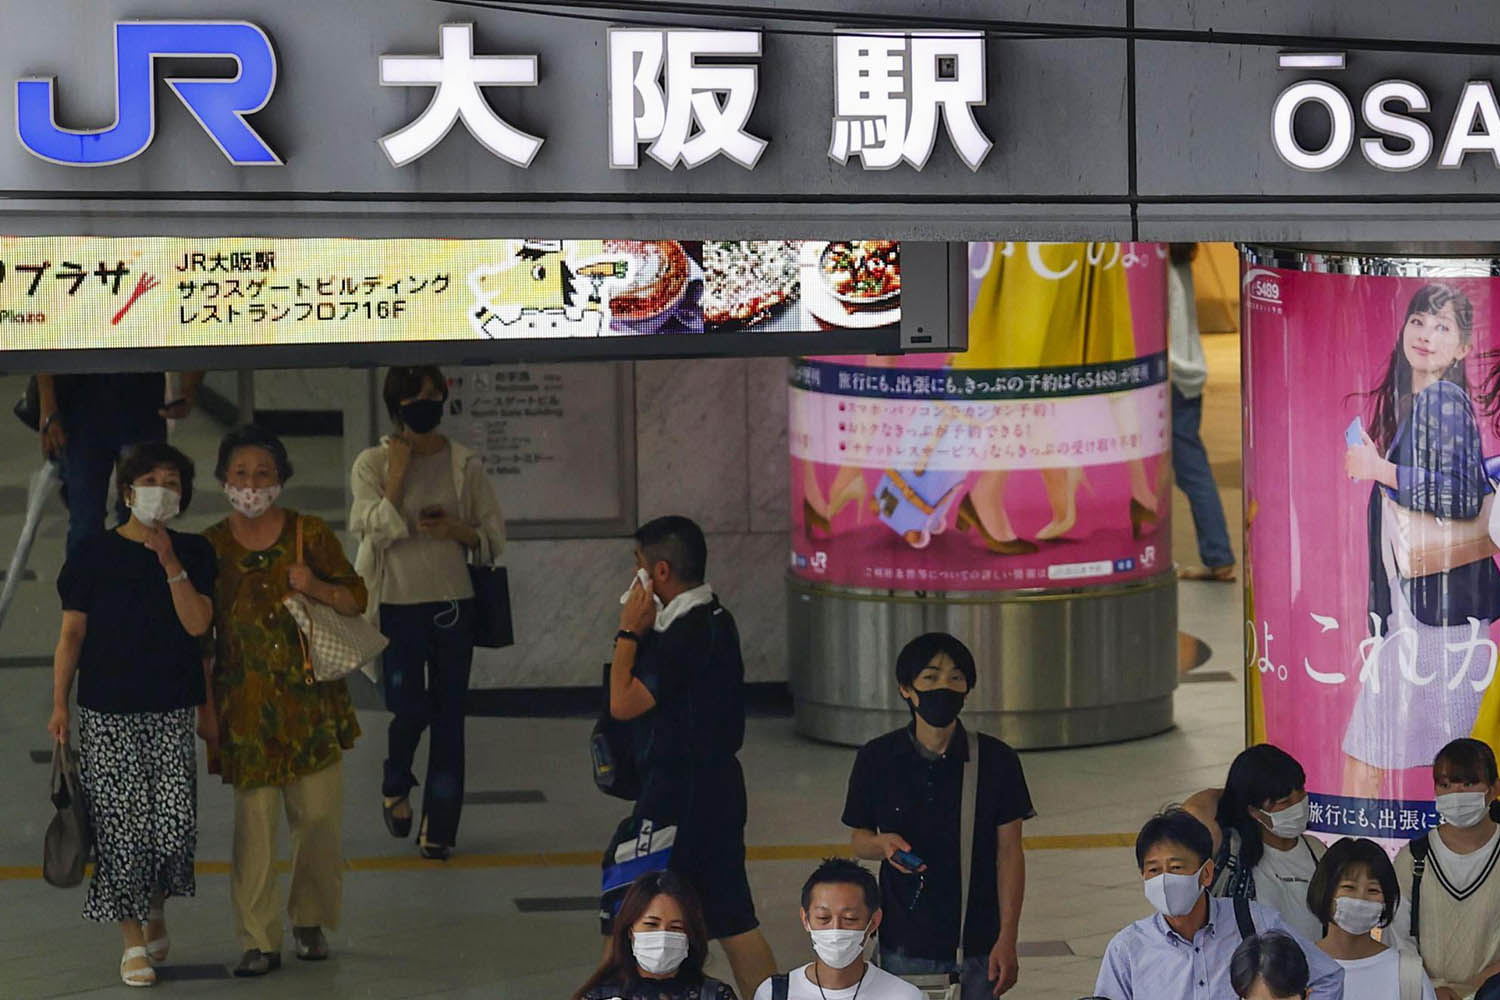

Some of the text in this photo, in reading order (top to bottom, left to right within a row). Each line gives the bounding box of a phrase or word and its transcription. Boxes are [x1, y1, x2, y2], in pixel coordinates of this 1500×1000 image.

[16, 19, 994, 171] JR 大阪駅
[176, 251, 277, 272] JR大阪駅
[177, 274, 450, 300] サウスゲートビルディング
